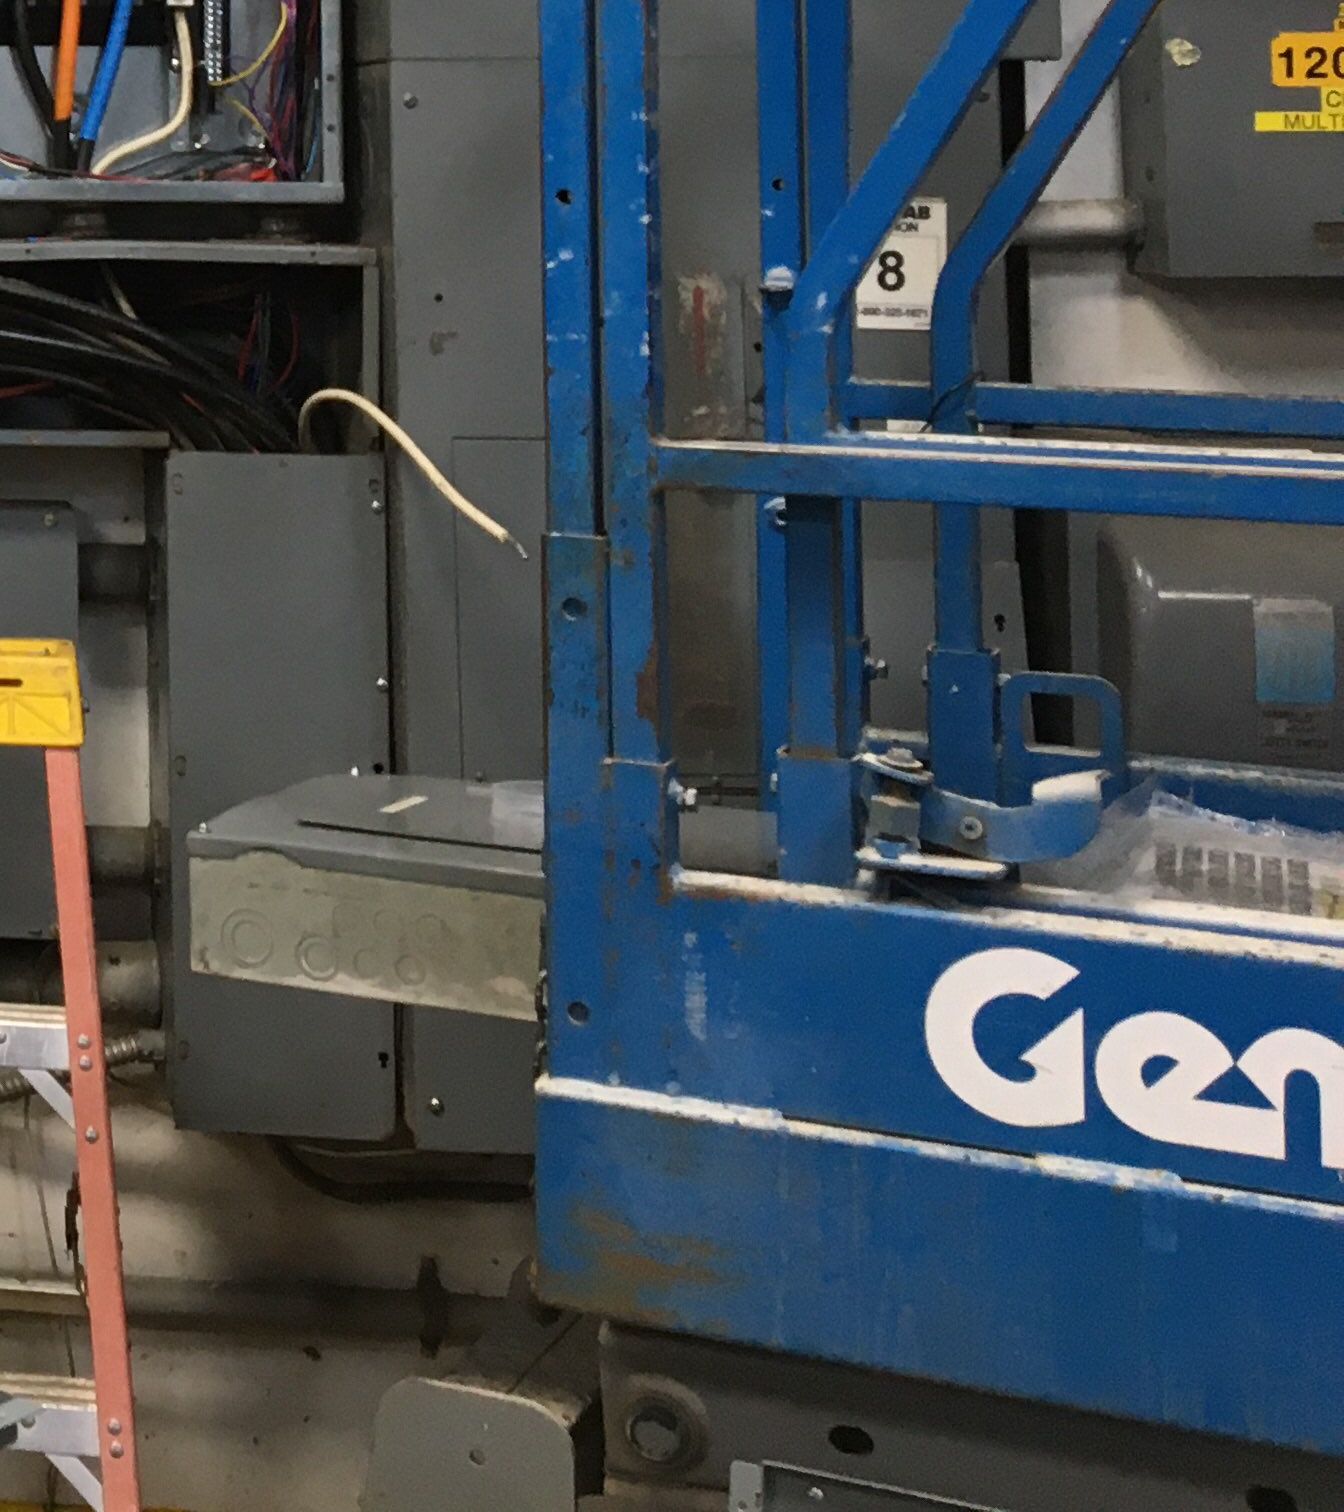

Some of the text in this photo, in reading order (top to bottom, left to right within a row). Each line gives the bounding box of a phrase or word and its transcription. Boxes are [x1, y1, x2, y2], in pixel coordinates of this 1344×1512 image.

[1325, 89, 1344, 109] C
[1284, 112, 1344, 131] MULT
[877, 250, 906, 292] 8
[924, 946, 1344, 1170] Gen
